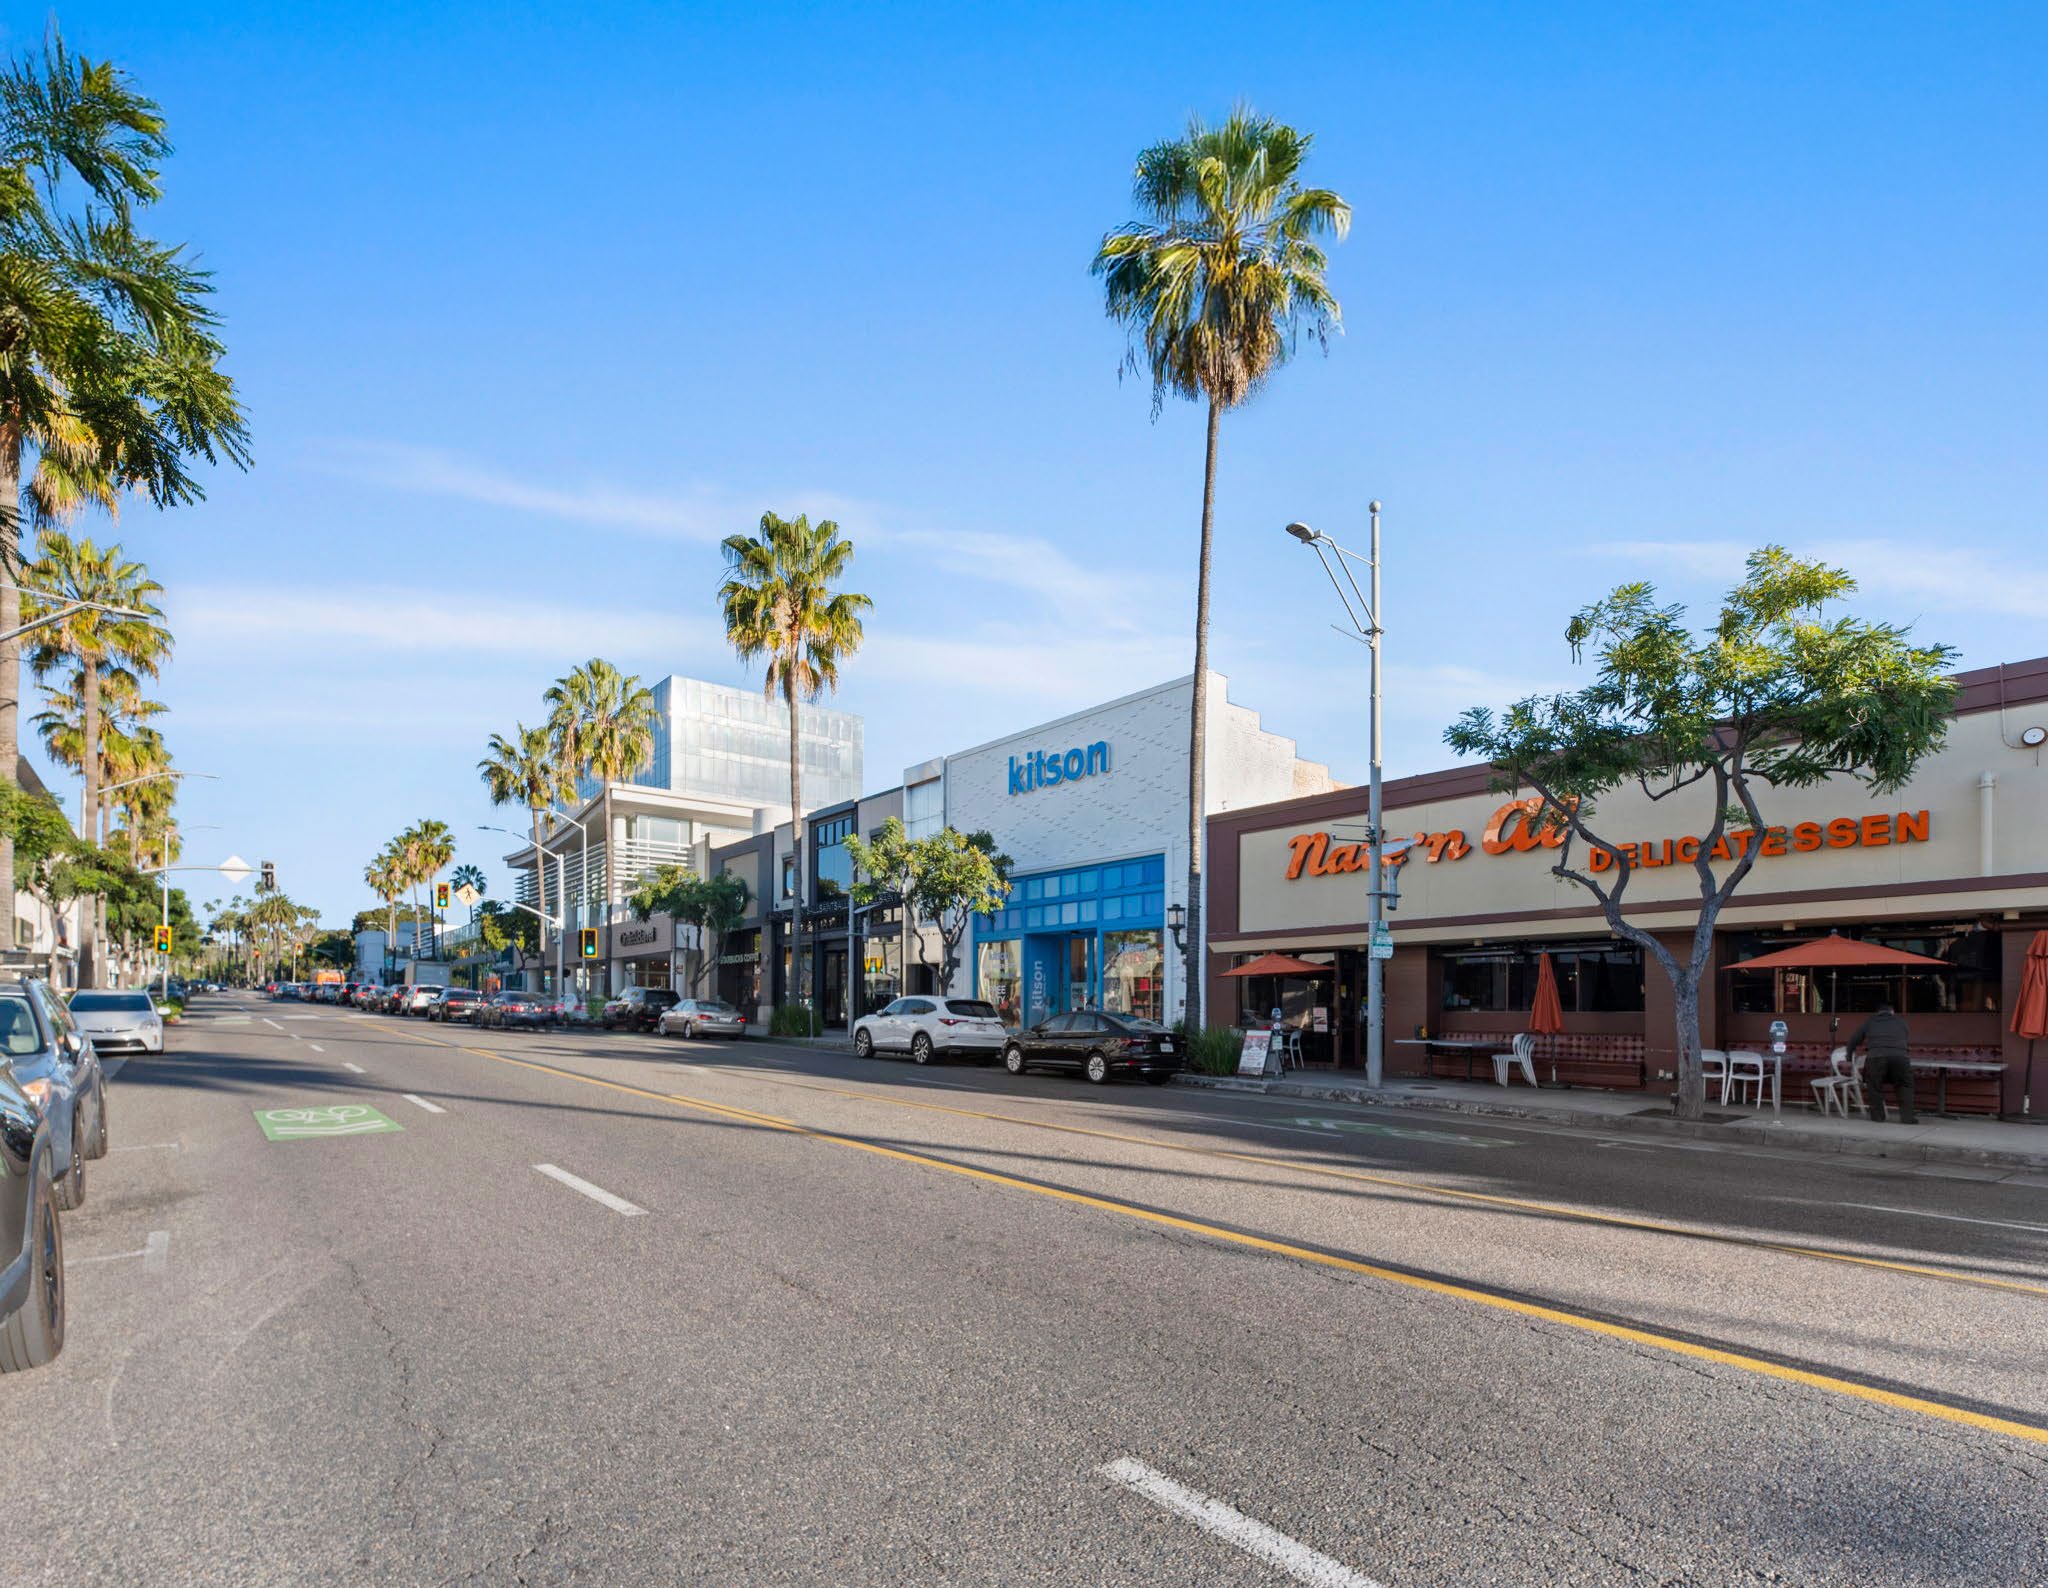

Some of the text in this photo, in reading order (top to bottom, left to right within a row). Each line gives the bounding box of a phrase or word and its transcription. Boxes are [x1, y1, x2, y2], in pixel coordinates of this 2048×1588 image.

[1008, 740, 1110, 796] kitson
[1285, 829, 1472, 880] Nae'n
[1589, 809, 1931, 873] DELICATESSEN
[1032, 960, 1043, 1009] kitson
